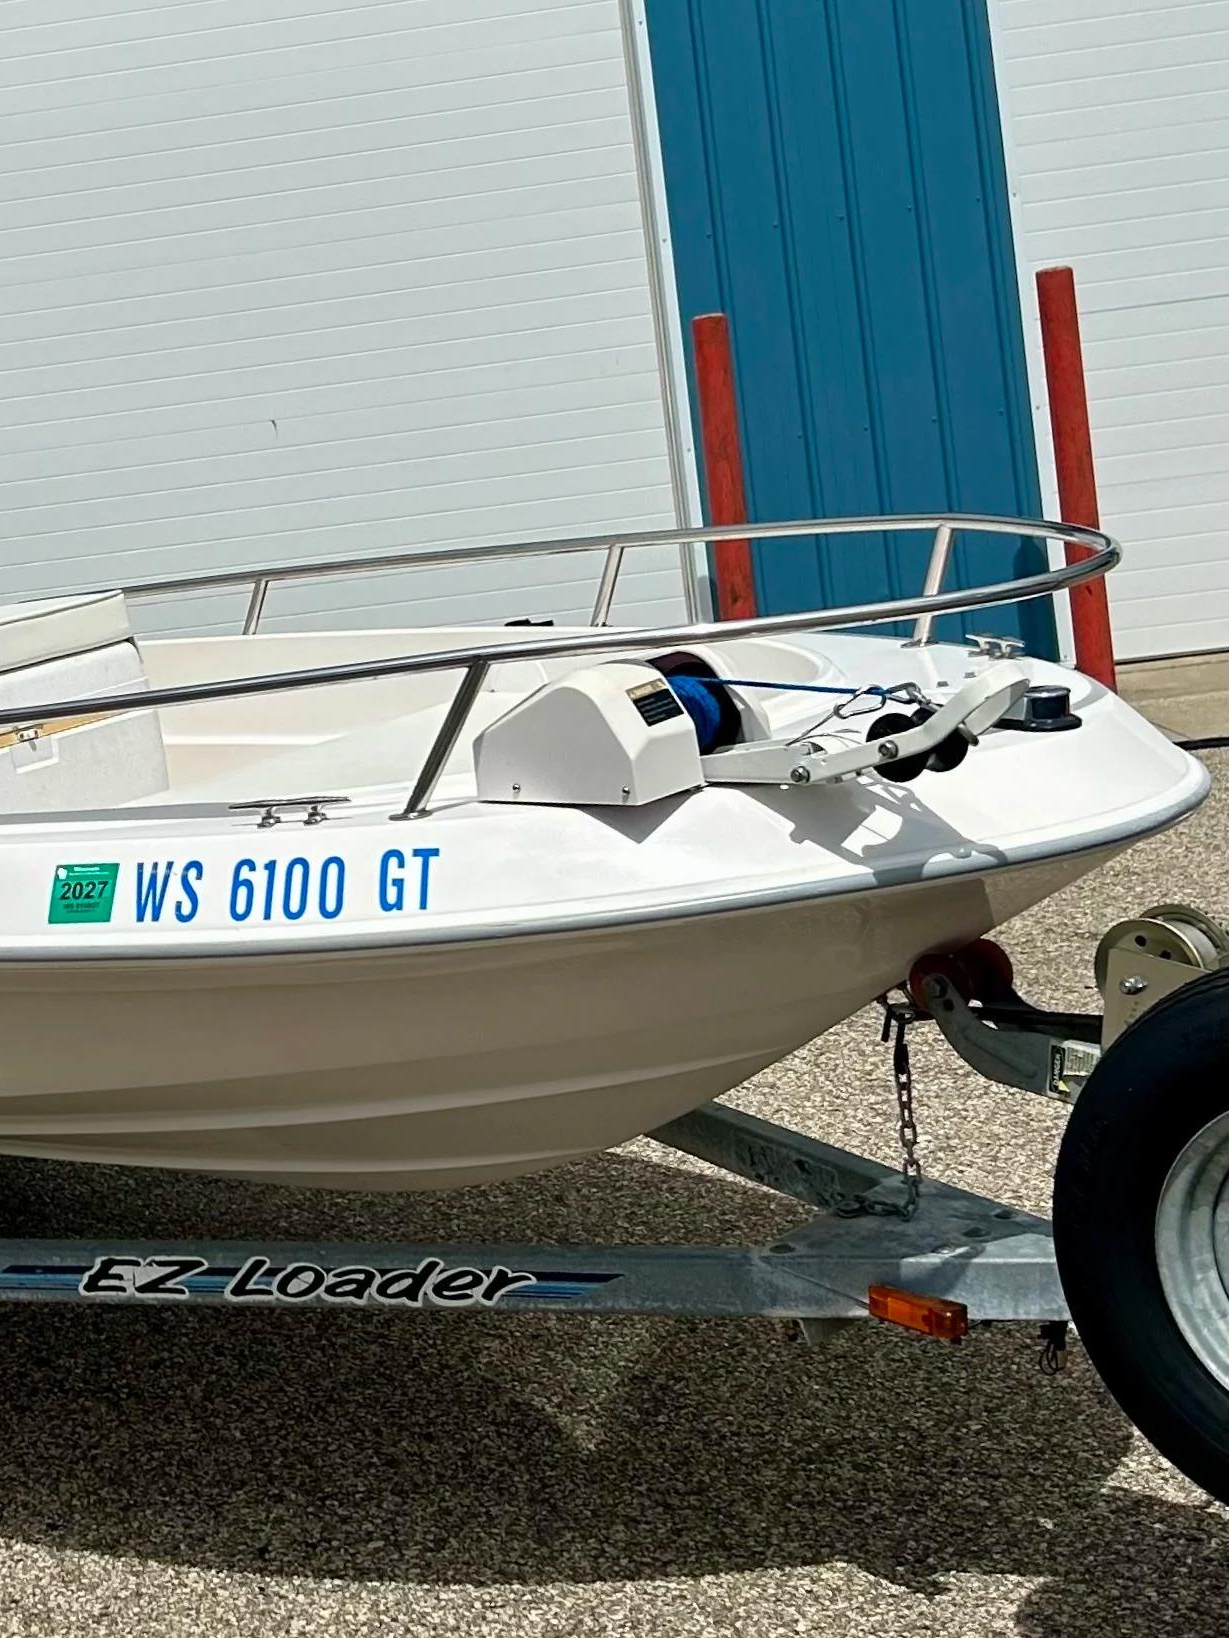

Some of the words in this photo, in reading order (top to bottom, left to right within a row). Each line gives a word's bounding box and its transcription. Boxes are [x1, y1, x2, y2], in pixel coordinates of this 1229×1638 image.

[59, 880, 110, 901] 2027
[135, 859, 204, 924] WS
[228, 855, 346, 922] 6100
[378, 847, 441, 913] GT
[78, 1255, 209, 1299] EZ
[224, 1256, 538, 1308] Loader
